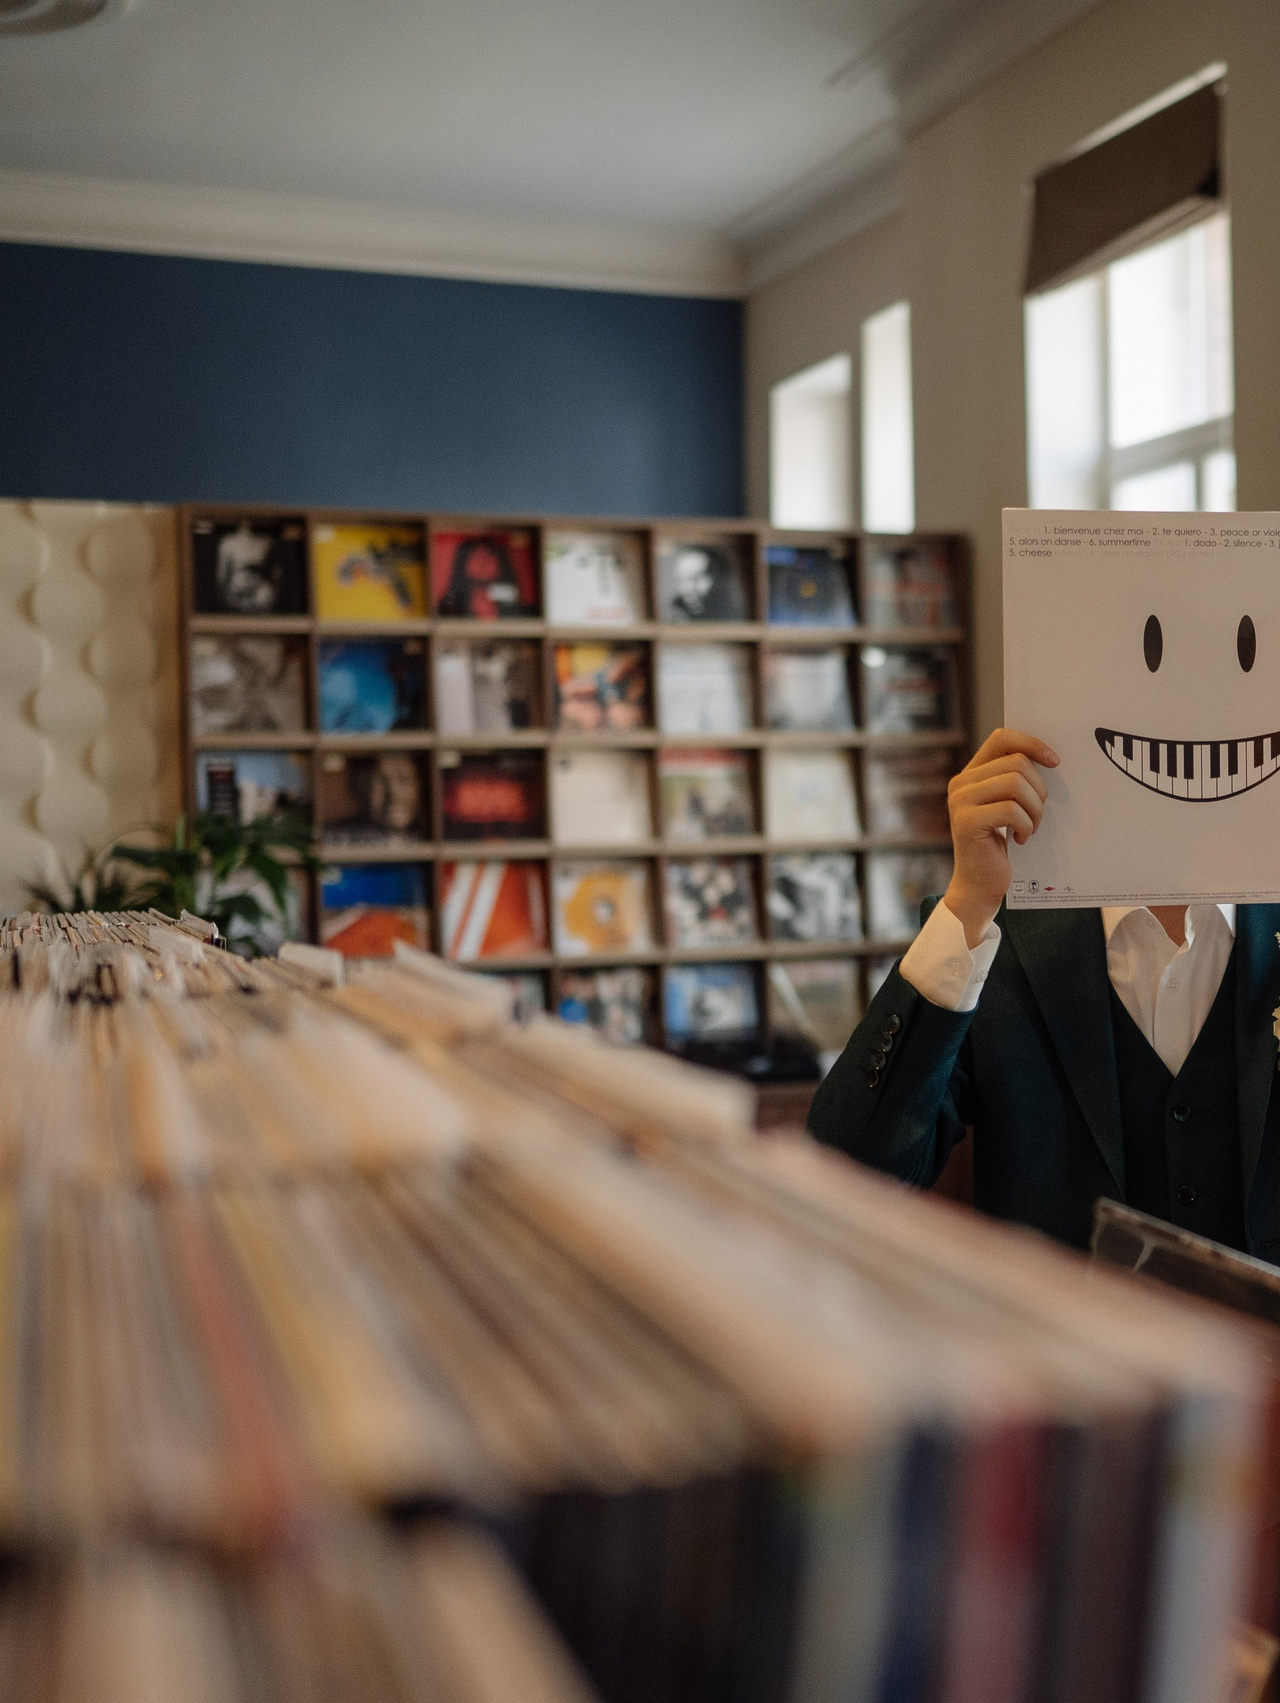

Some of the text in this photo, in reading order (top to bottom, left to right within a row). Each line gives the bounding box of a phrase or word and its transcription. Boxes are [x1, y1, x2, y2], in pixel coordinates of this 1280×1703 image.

[1044, 527, 1051, 535] 1.
[1053, 527, 1101, 535] bienvenue
[1103, 527, 1125, 536] chez
[1127, 527, 1144, 536] moi
[1152, 527, 1160, 536] 2.
[1162, 528, 1172, 536] te
[1173, 528, 1202, 538] quiero
[1209, 528, 1218, 536] 3.
[1219, 529, 1250, 538] peace
[1009, 538, 1016, 546] 5.
[1018, 538, 1039, 546] alors
[1040, 538, 1053, 546] on
[1054, 538, 1082, 546] danse
[1089, 538, 1097, 547] 6.
[1098, 538, 1151, 547] summertime
[1184, 539, 1191, 547] 1.
[1193, 539, 1217, 548] dodo
[1223, 539, 1232, 548] 2.
[1233, 539, 1262, 548] silence
[1269, 539, 1277, 548] 3.
[1009, 549, 1016, 557] 5.
[1018, 549, 1053, 558] cheese
